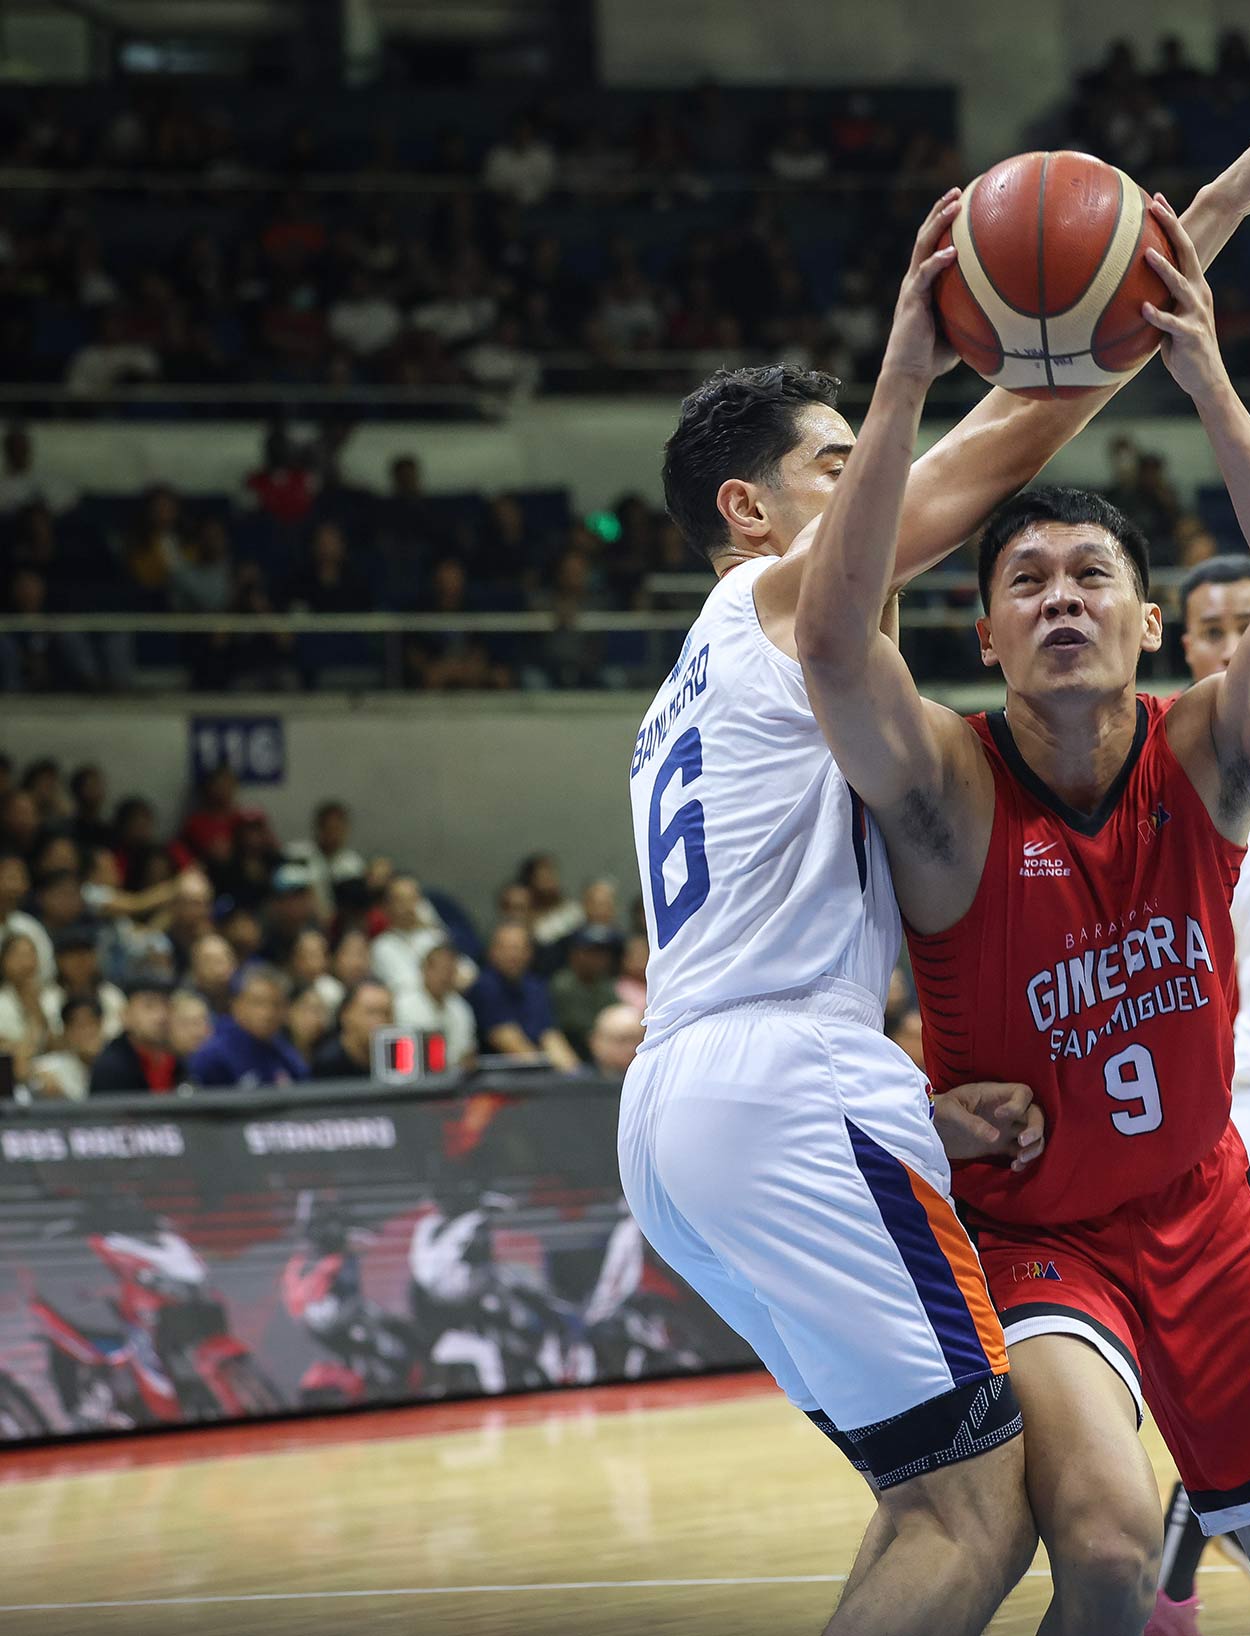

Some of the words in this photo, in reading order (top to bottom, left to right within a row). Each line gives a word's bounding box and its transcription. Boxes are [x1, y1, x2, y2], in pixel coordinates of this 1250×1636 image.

[648, 726, 710, 950] 6
[1024, 859, 1064, 868] WORLD
[1103, 1043, 1163, 1136] 9
